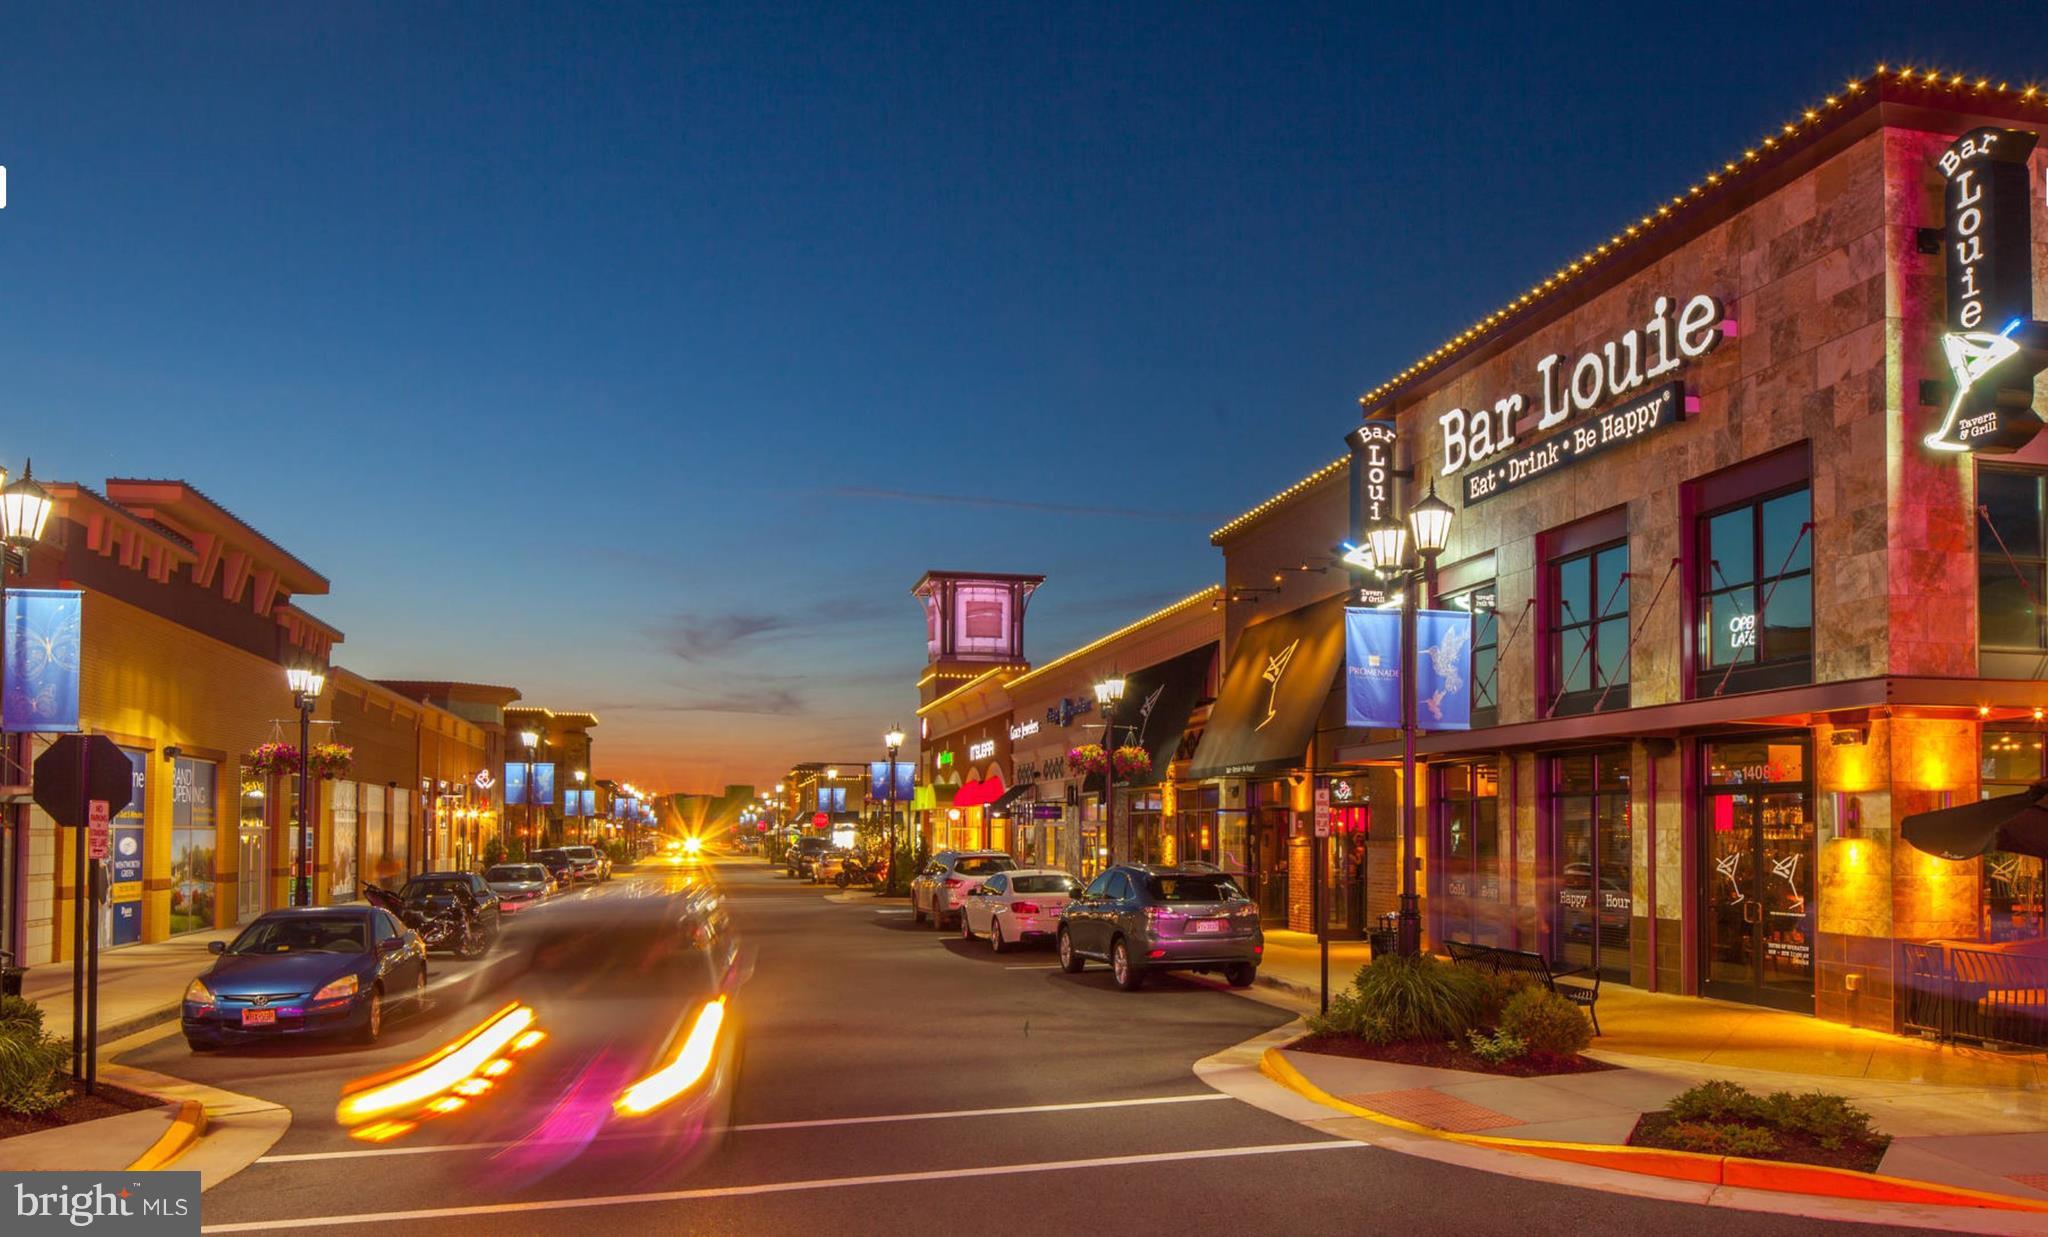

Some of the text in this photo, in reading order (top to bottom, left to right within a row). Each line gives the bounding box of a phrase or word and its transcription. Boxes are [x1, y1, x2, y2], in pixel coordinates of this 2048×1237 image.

[1939, 133, 1999, 177] Bar
[1957, 171, 1984, 329] Louie
[1439, 295, 1715, 478] Bar Louie
[1358, 426, 1397, 443] Bar
[1959, 411, 1997, 430] Tavern
[1970, 420, 1997, 437] Grill
[1469, 470, 1497, 500] Eat
[1508, 443, 1559, 482] Drink
[1574, 427, 1598, 455] Be
[1367, 445, 1386, 521] Loui
[1349, 666, 1400, 678] PROMENADE
[1560, 890, 1631, 909] Happy Hour
